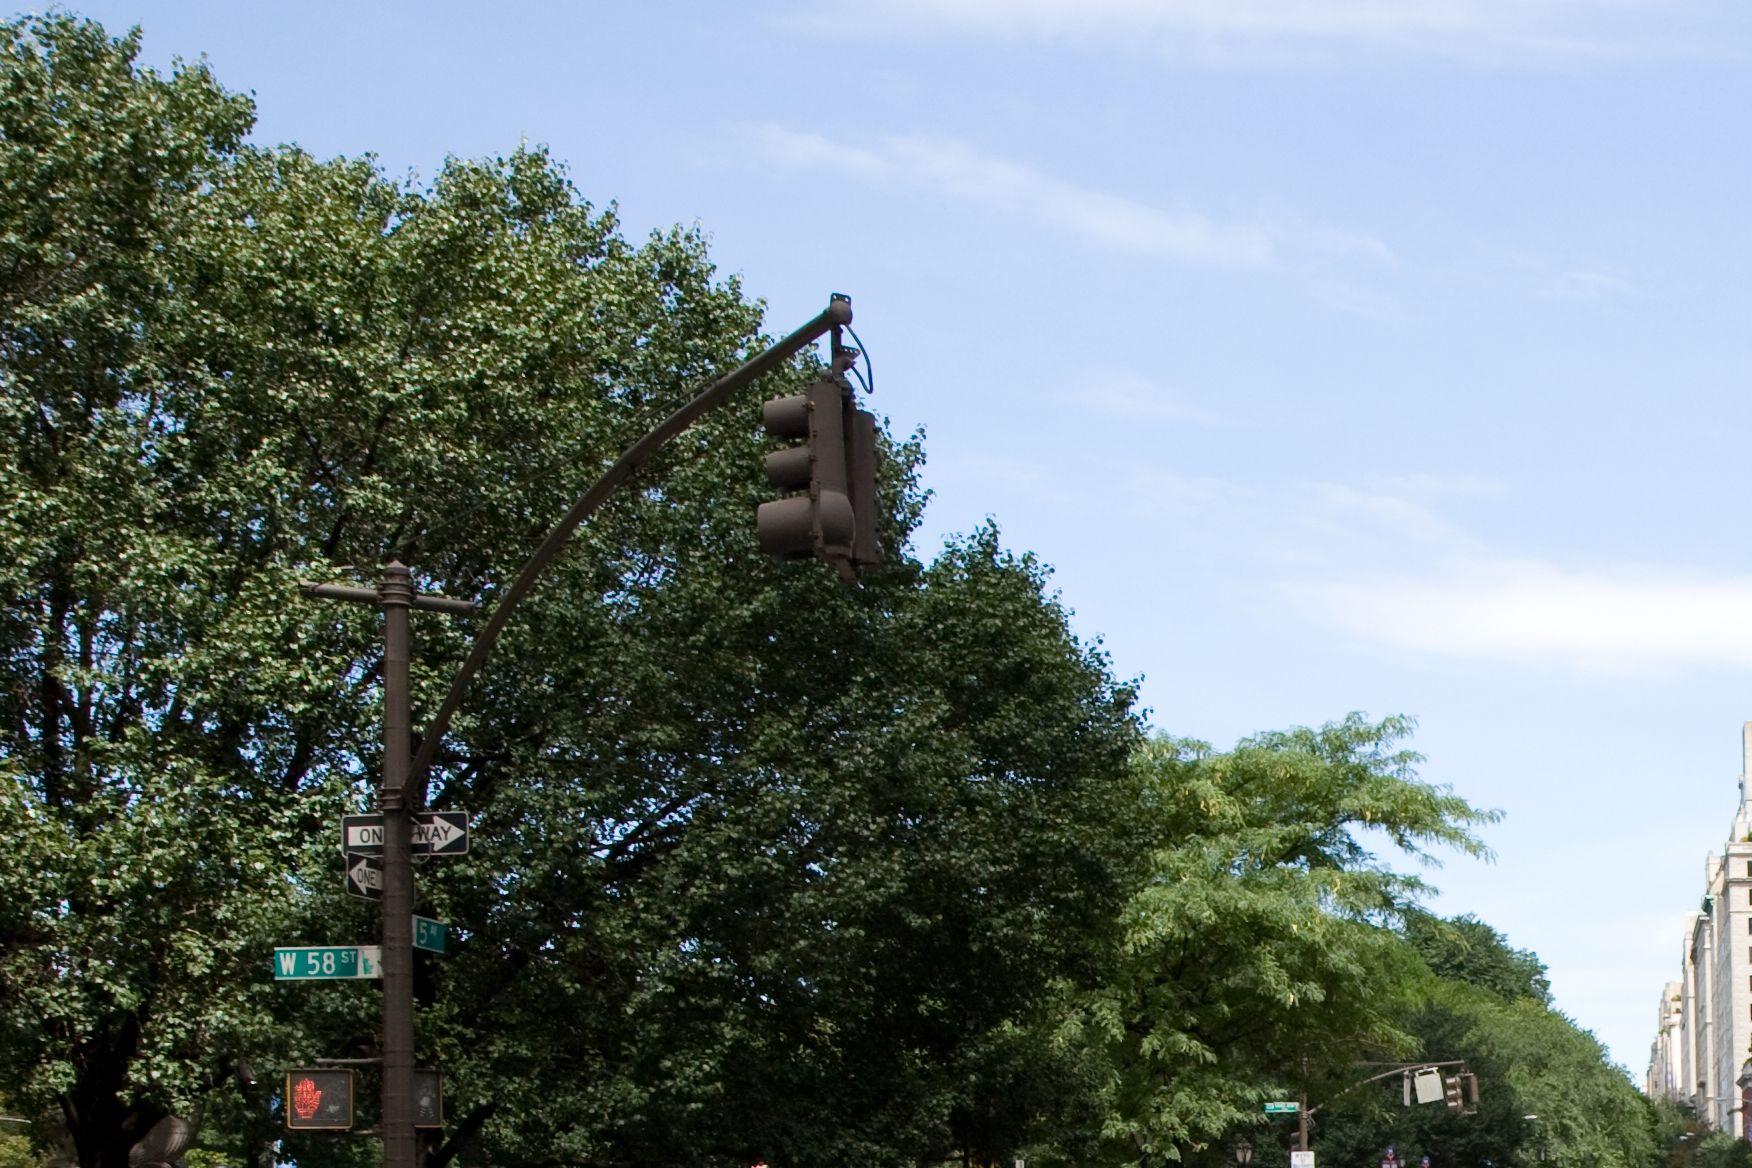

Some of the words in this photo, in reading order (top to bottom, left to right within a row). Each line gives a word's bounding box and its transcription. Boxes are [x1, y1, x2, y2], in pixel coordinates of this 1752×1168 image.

[359, 828, 383, 844] ON
[417, 826, 452, 841] WAY
[357, 868, 376, 886] ONE
[419, 923, 428, 945] 5
[279, 952, 297, 976] W
[307, 951, 336, 975] 58
[341, 951, 357, 964] ST
